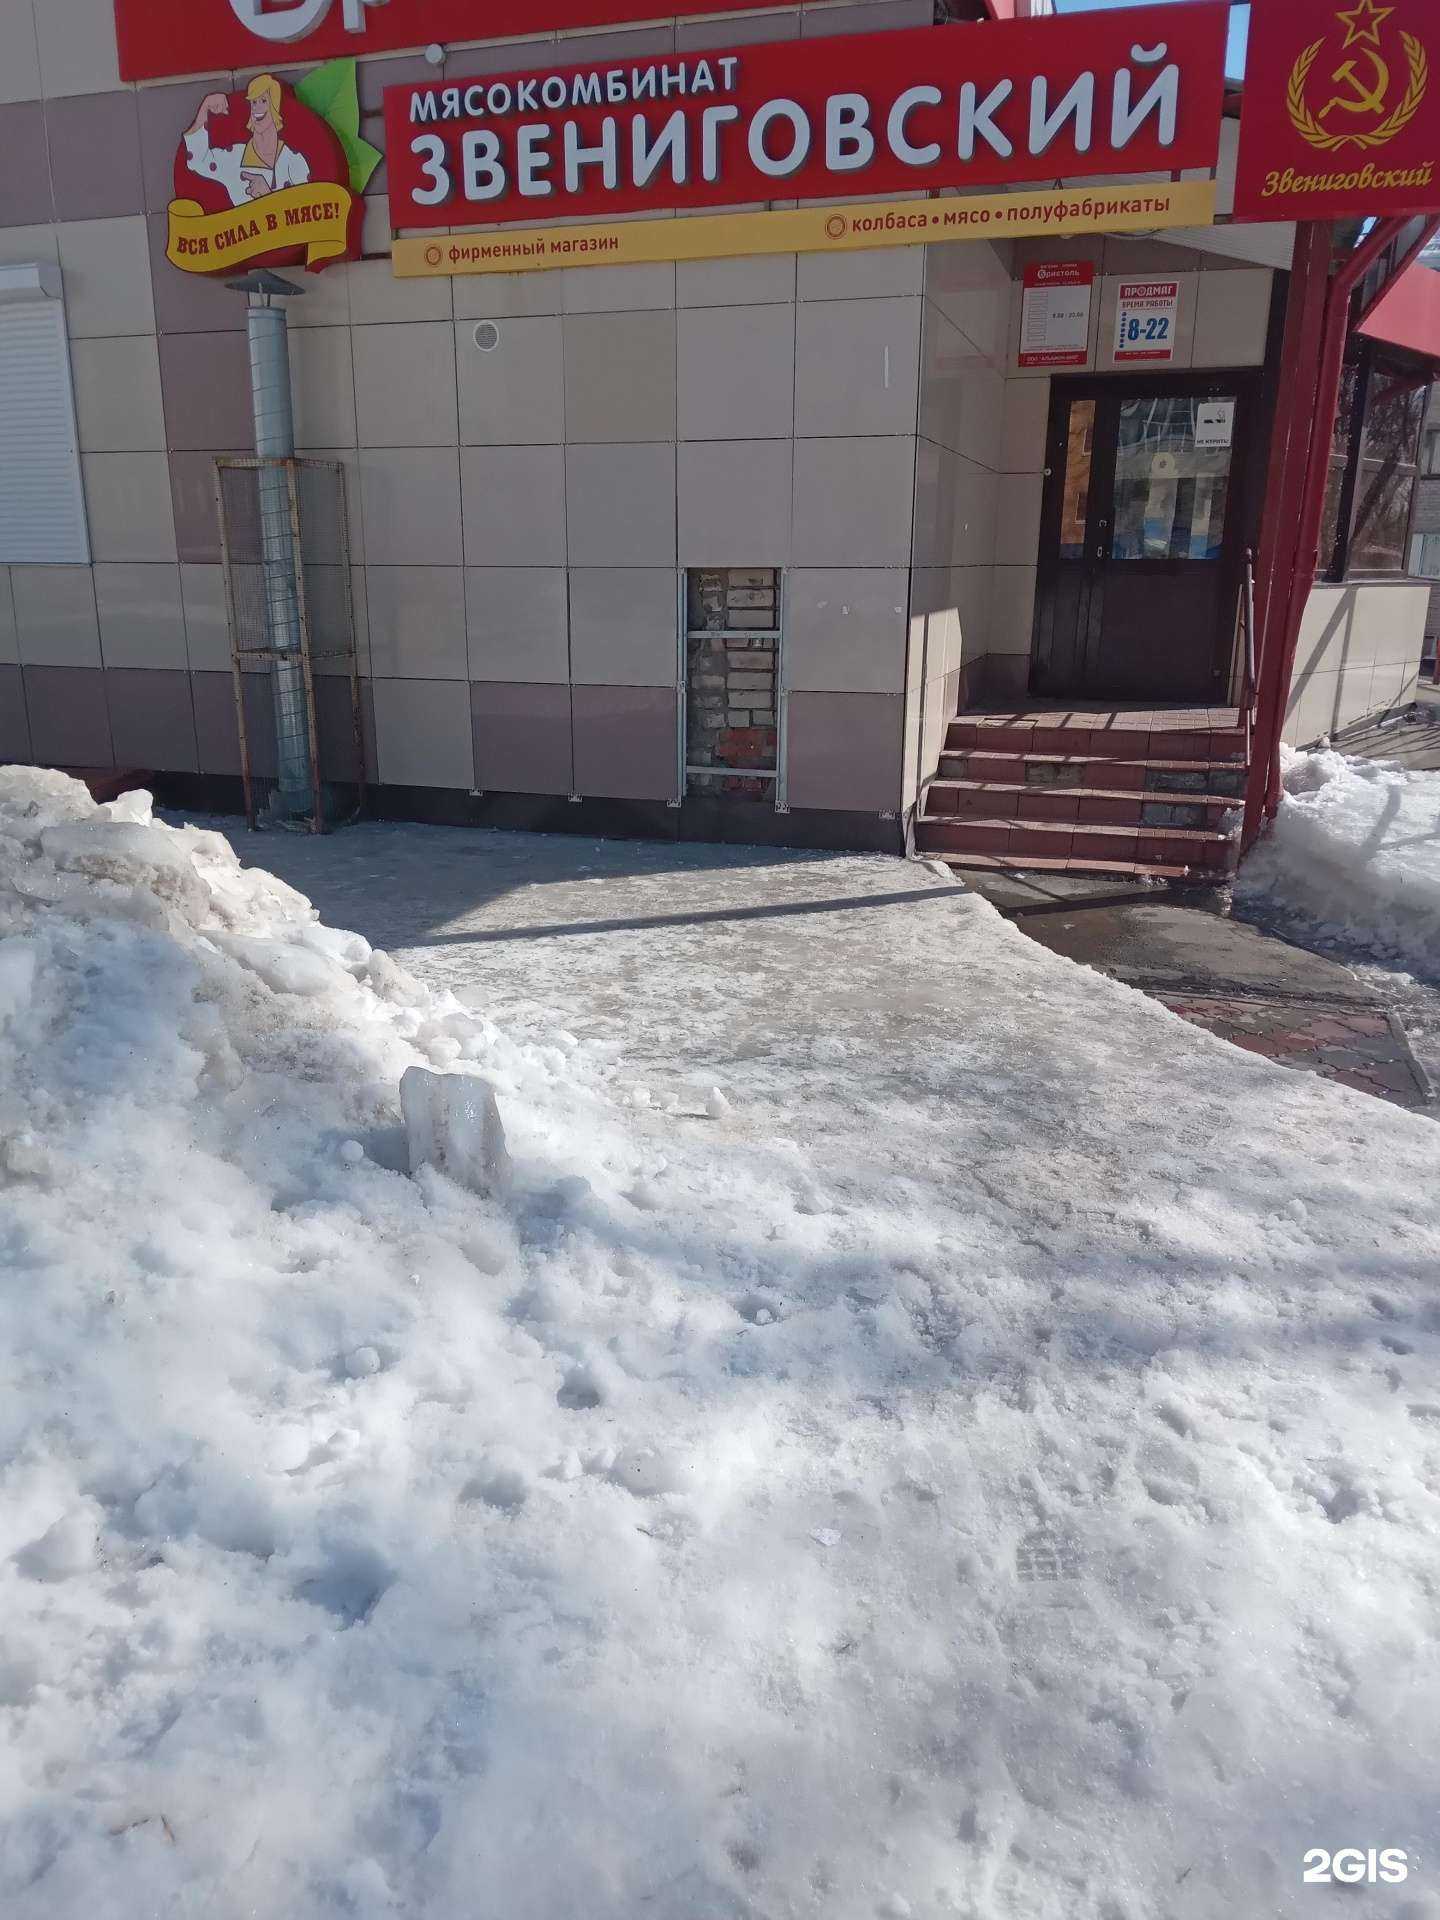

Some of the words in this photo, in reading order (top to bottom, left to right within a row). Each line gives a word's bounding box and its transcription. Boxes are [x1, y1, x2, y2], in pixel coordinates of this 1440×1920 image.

[409, 57, 738, 123] МЯСОКОМБИНАТ
[410, 42, 1179, 205] ЗВЕНИГОВСКИЙ
[1261, 160, 1435, 197] Звениговский
[176, 236, 209, 255] ВСЯ
[214, 220, 261, 250] СИЛА
[265, 214, 278, 231] В
[284, 202, 340, 226] МЯСЕ!
[852, 209, 928, 232] колбаса
[943, 209, 990, 226] мясо
[1006, 197, 1171, 222] полуфабрикаты
[448, 239, 545, 263] фирменный
[550, 236, 619, 253] магазин
[1127, 317, 1170, 341] 8-22
